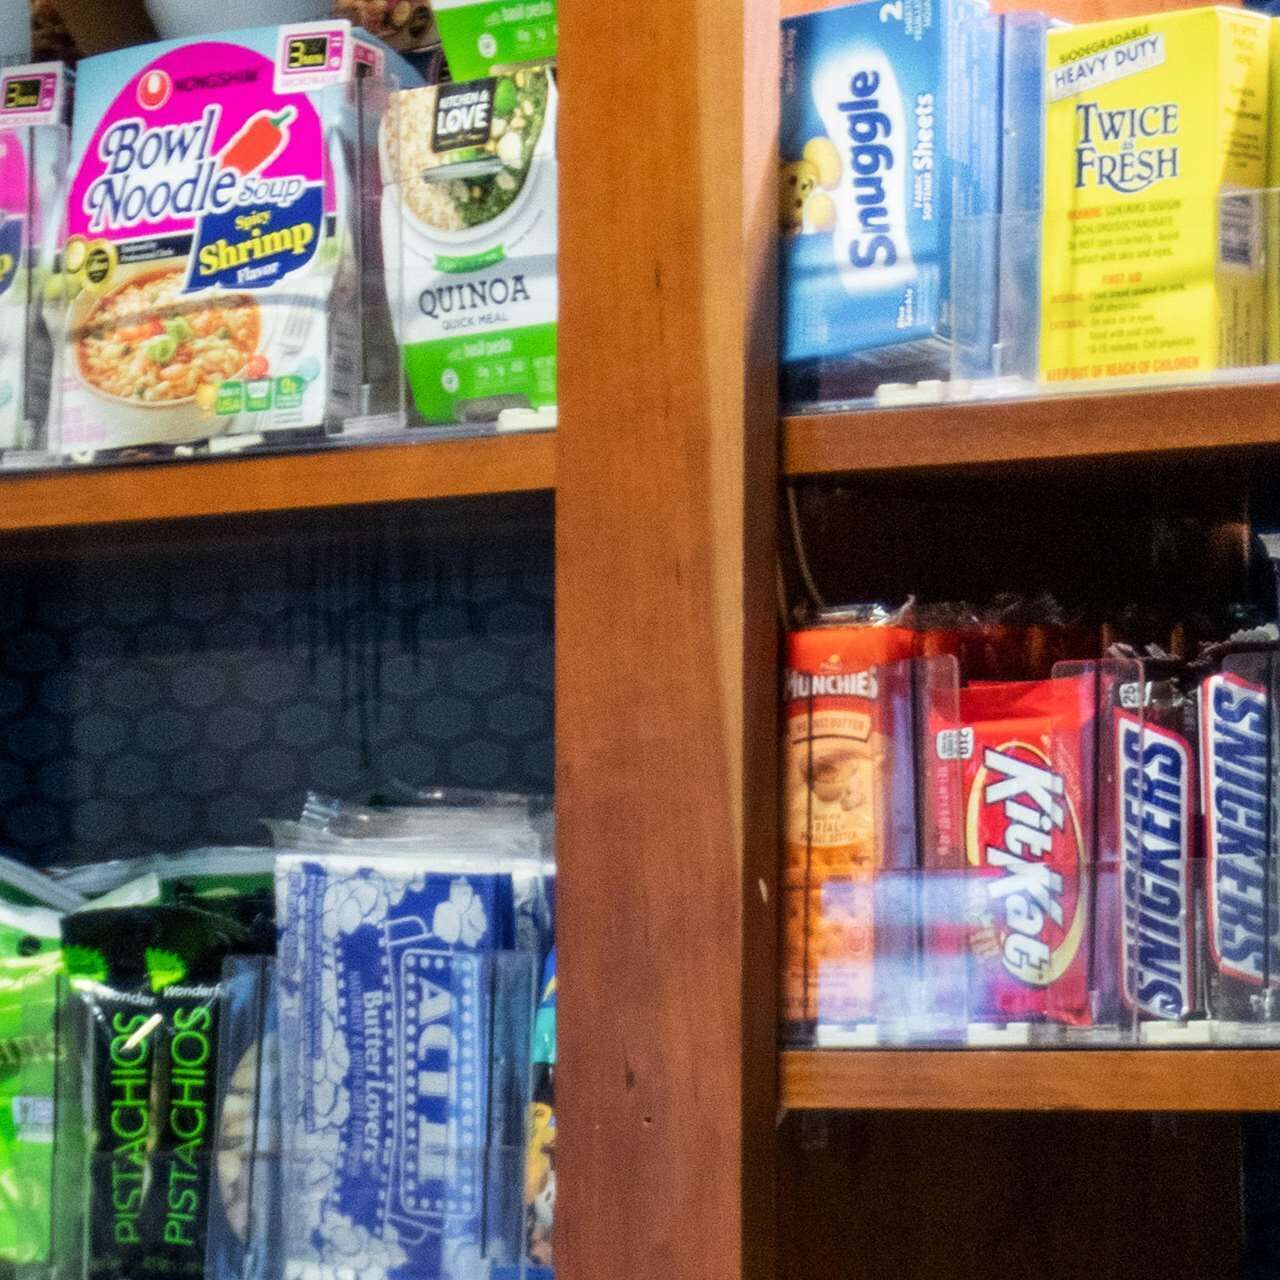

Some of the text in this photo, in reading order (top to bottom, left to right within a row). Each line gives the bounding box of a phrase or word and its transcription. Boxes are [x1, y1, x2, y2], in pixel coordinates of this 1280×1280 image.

[1054, 37, 1160, 89] HEAVY DUTY
[1059, 25, 1150, 65] BIODEGRADABLE
[175, 67, 260, 92] NONGSHIM
[438, 93, 477, 108] KITCHEN
[101, 107, 221, 176] Bowl
[437, 104, 489, 135] LOVE
[913, 93, 934, 169] Sheets
[1075, 102, 1178, 145] TWICE
[88, 161, 302, 229] Noodle Soup
[839, 69, 898, 269] Snuggle
[1075, 146, 1178, 193] FRESH
[234, 210, 272, 231] Spicy
[199, 223, 313, 275] Shrimp
[420, 275, 531, 318] QUINOA
[440, 312, 509, 332] QUICK MEAL
[787, 669, 878, 700] MUNCHIES
[1122, 728, 1183, 1018] SNICKERS
[361, 990, 387, 1164] Butter Lovers
[416, 977, 460, 1184] ACT II
[101, 1010, 151, 1247] PISTACHIOS
[164, 1005, 216, 1246] PISTACHIOS
